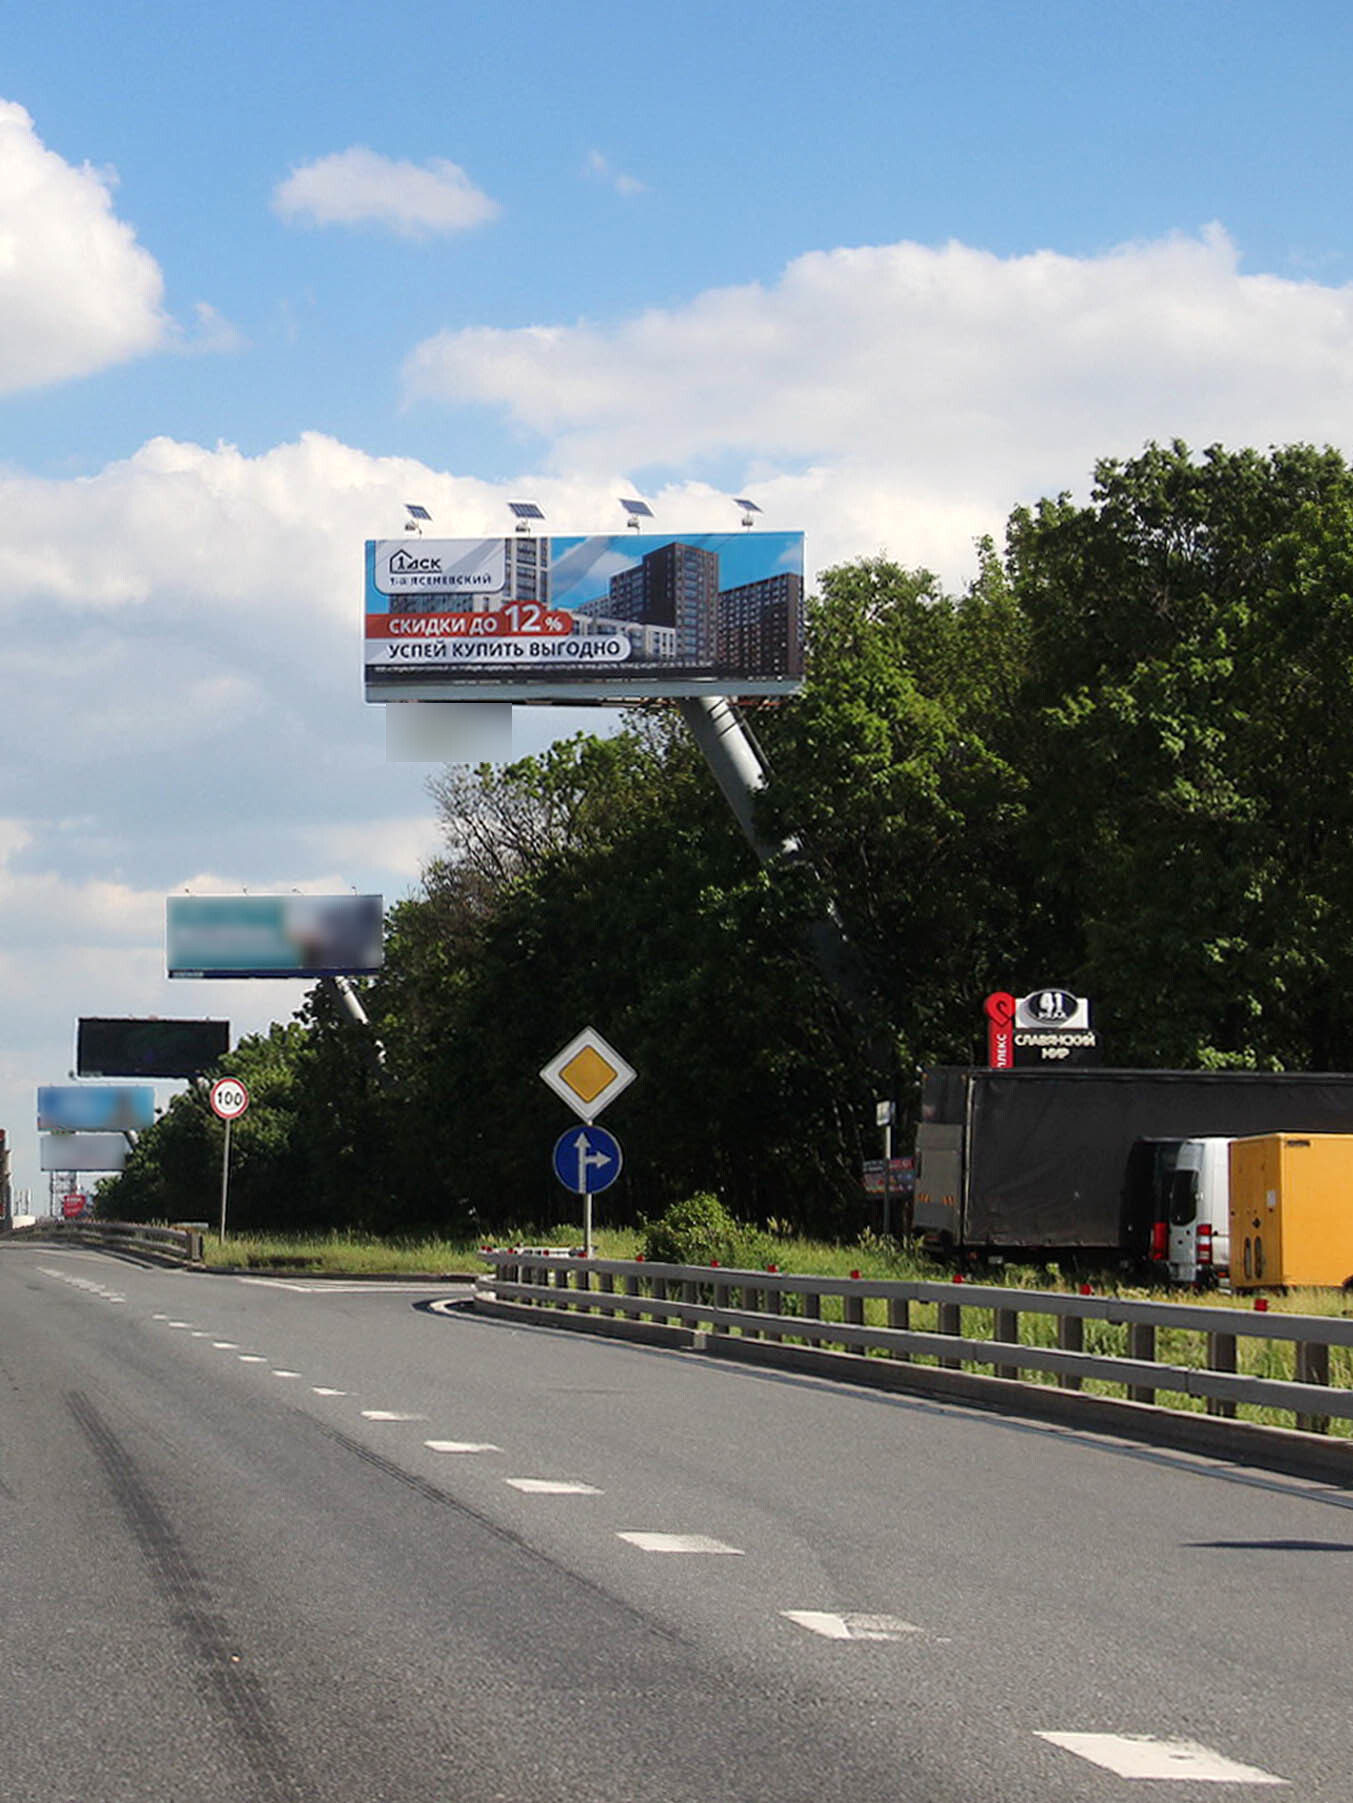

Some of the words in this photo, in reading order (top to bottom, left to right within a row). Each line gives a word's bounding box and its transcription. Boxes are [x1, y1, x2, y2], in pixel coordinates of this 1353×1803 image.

[388, 617, 467, 637] СКИДКИ
[469, 617, 497, 636] ДО
[388, 640, 447, 659] УСПЕЙ
[452, 641, 525, 659] КУПИТЬ
[529, 640, 621, 660] ВЫГОДНО
[218, 1091, 244, 1106] 100
